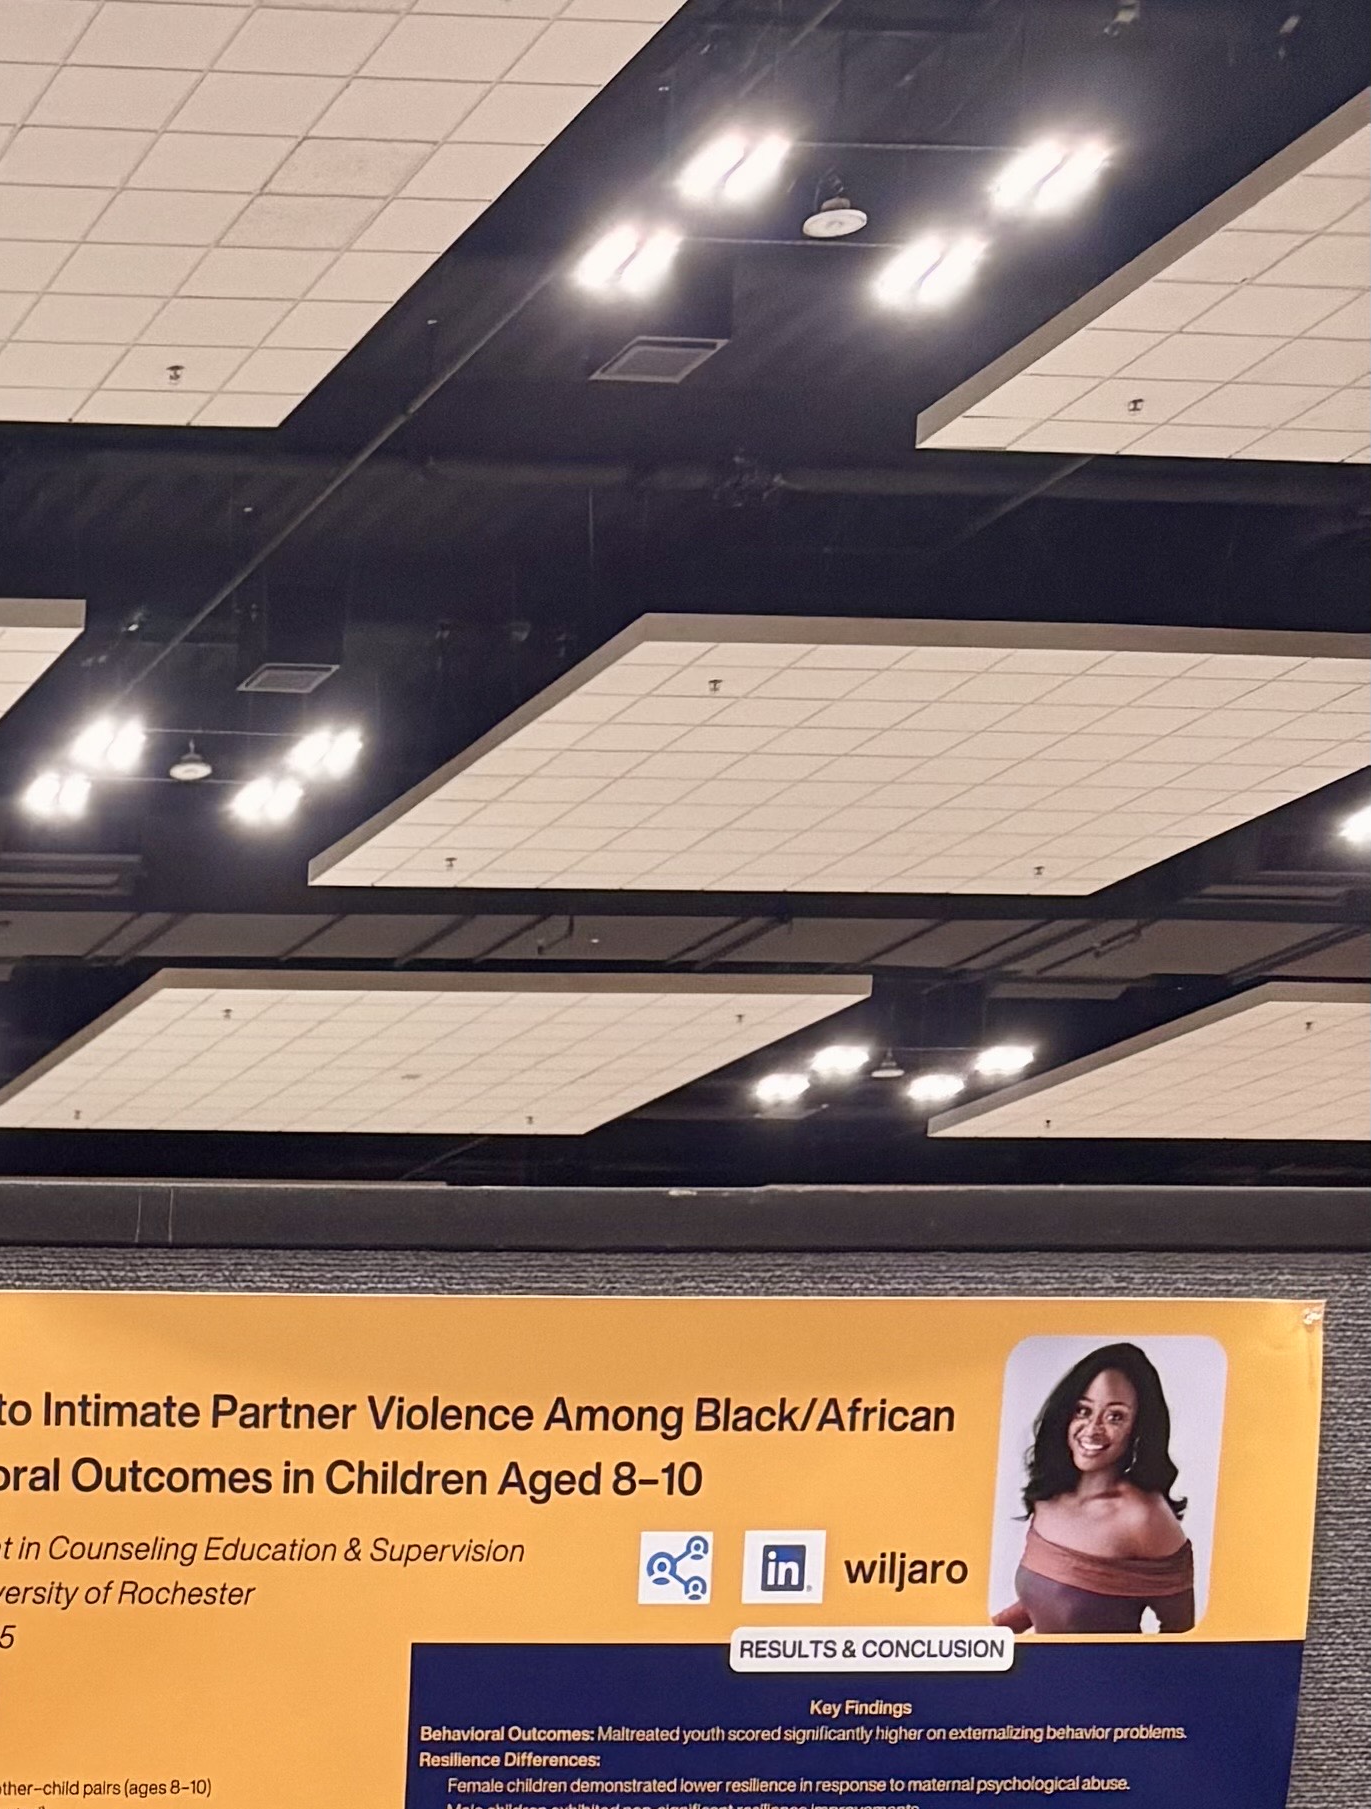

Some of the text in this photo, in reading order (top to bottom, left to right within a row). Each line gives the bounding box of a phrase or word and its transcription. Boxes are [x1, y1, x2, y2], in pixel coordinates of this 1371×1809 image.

[43, 1391, 200, 1428] Intimate
[211, 1393, 357, 1429] Partner
[367, 1395, 534, 1431] Violence
[543, 1396, 683, 1440] Among
[695, 1397, 954, 1432] Black/African
[71, 1456, 272, 1493] Outcomes
[282, 1460, 314, 1494] in
[325, 1459, 487, 1495] Children
[497, 1461, 601, 1504] Aged
[17, 1535, 40, 1560] in
[48, 1535, 197, 1566] Counseling
[203, 1536, 336, 1561] Education
[343, 1536, 361, 1561] &
[369, 1537, 524, 1567] Supervision
[844, 1551, 969, 1592] wiljaro
[84, 1579, 114, 1604] of
[117, 1580, 256, 1605] Rochester
[739, 1639, 1004, 1658] RESULTS & CONCLUSION
[809, 1699, 912, 1718] Key Findings
[82, 1780, 121, 1798] pairs
[124, 1778, 166, 1798] (ages
